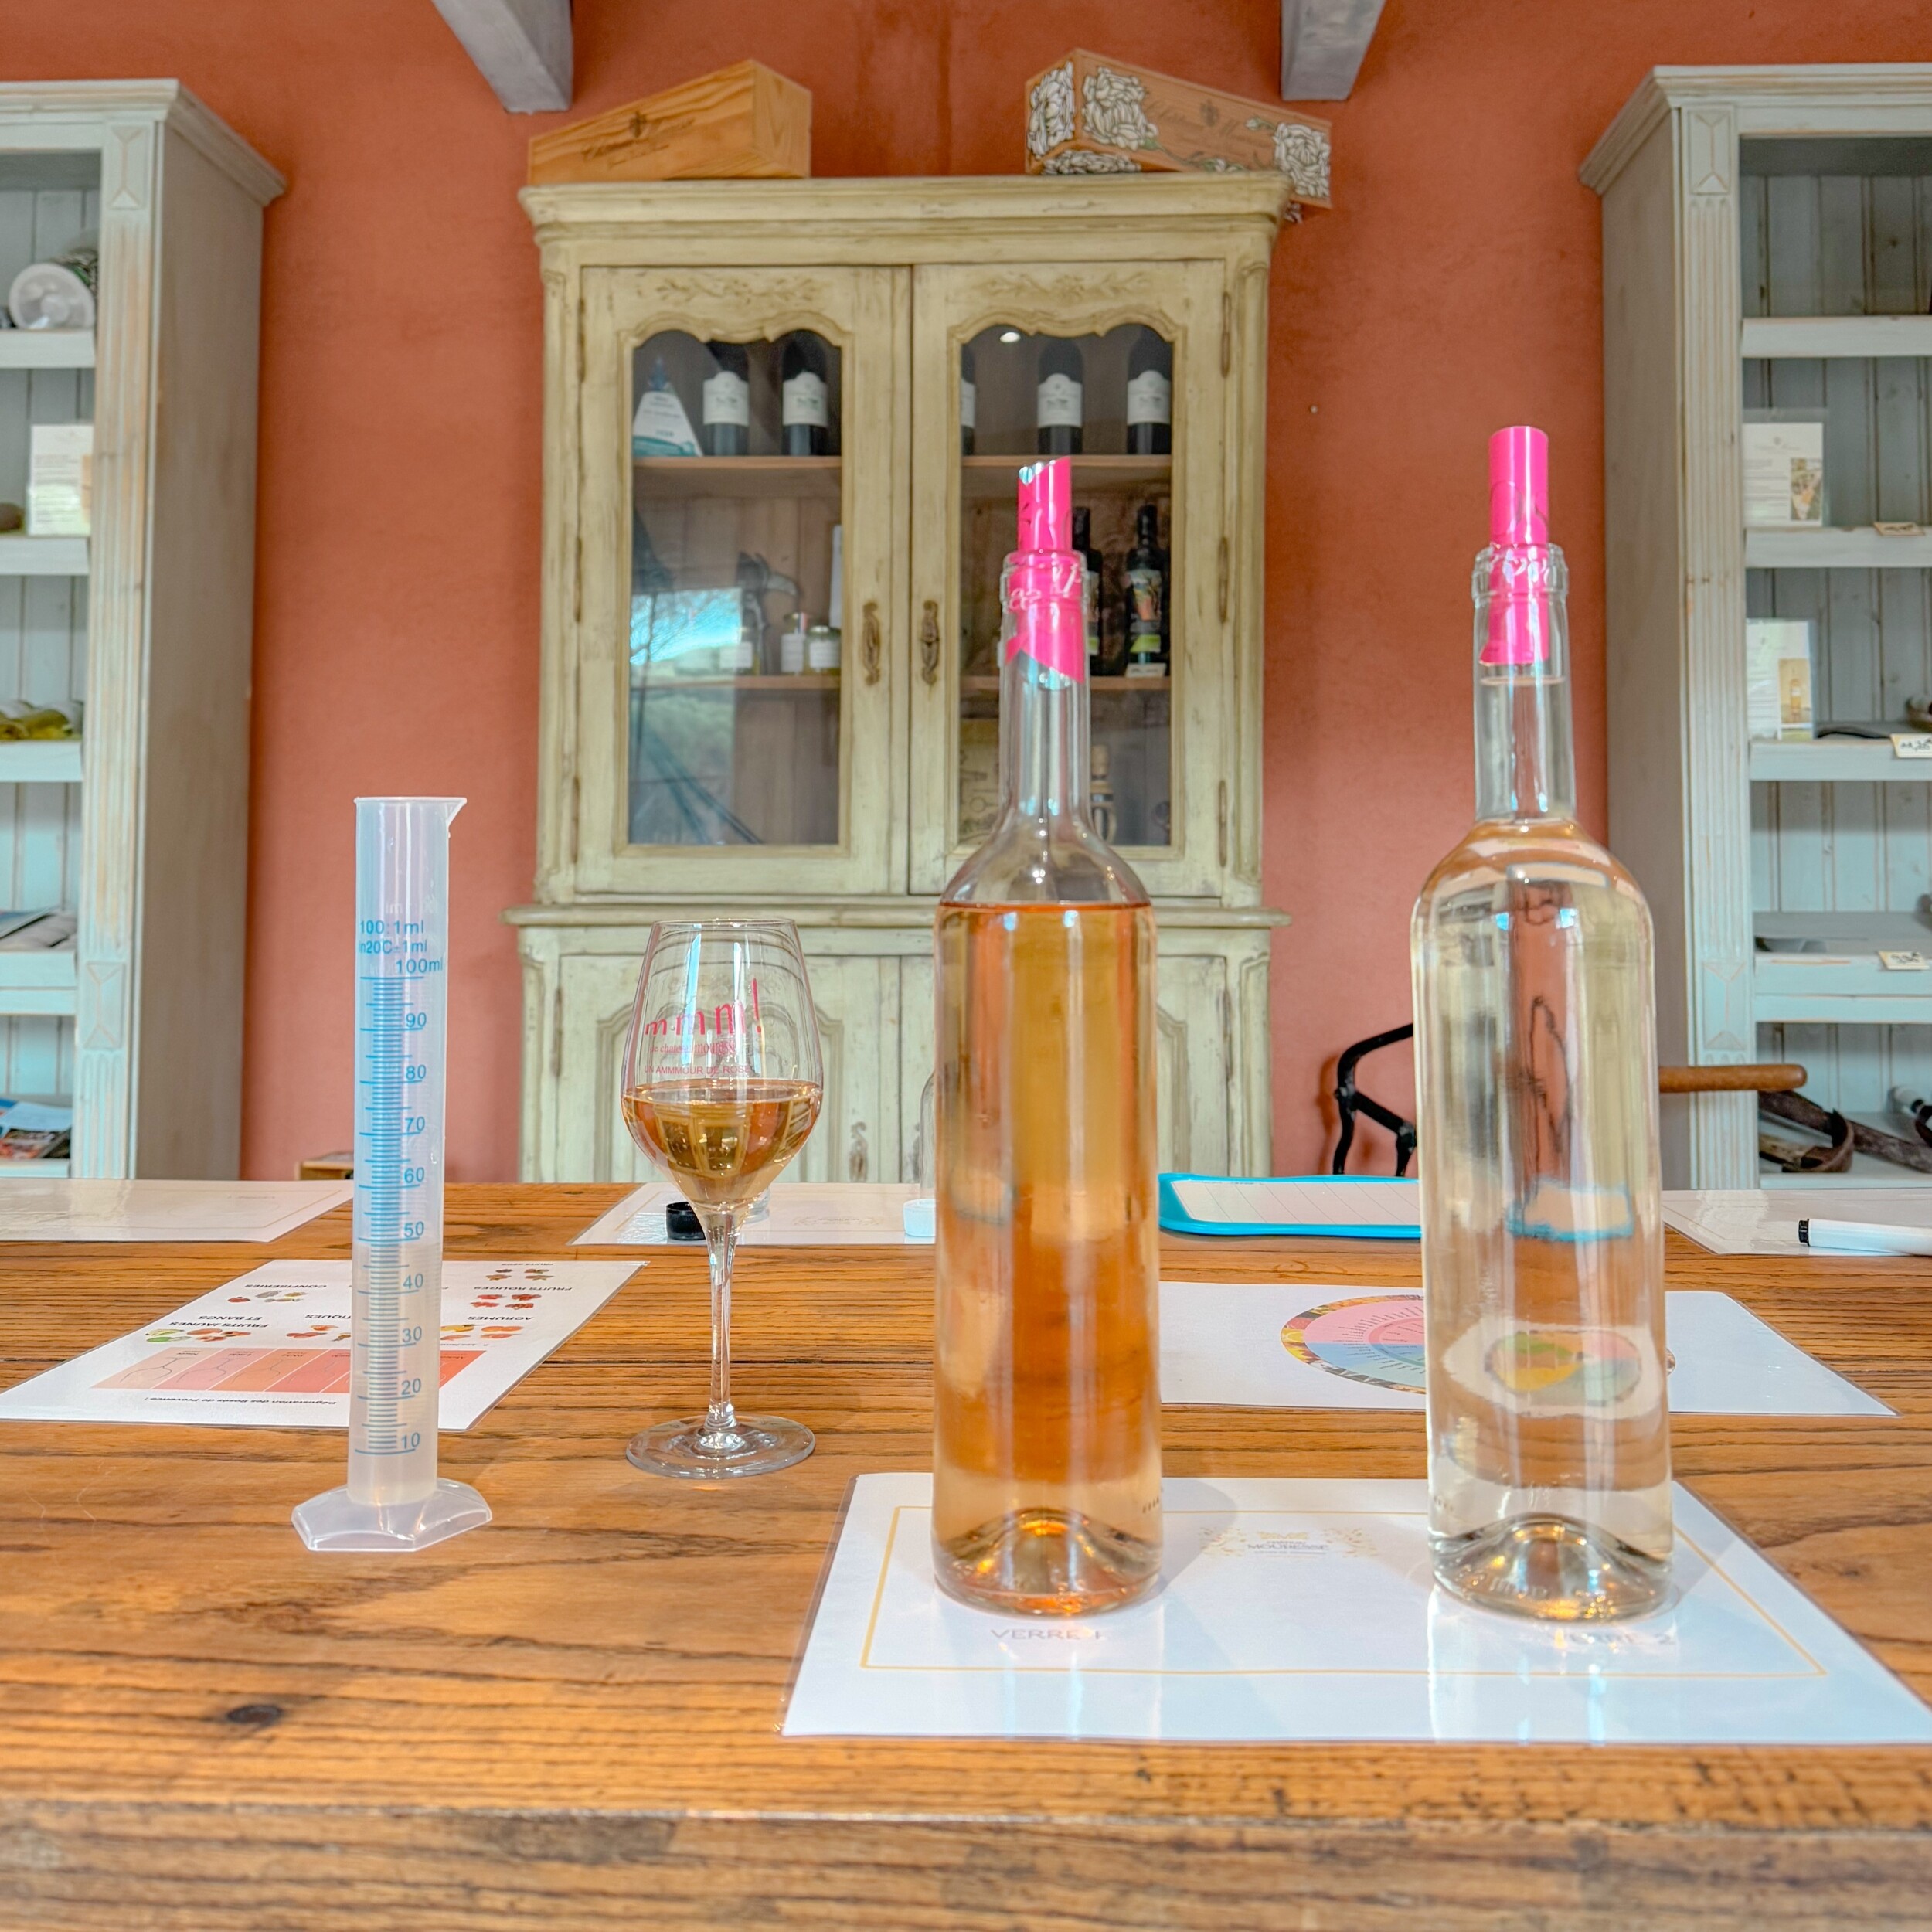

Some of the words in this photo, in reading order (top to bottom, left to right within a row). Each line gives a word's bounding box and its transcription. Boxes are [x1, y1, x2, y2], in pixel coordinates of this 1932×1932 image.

[406, 1012, 427, 1029] 90
[406, 1064, 427, 1080] 80
[655, 1066, 704, 1075] AMMMOUR
[405, 1116, 426, 1133] 70
[403, 1167, 425, 1184] 60
[403, 1221, 424, 1238] 50
[403, 1273, 423, 1290] 40
[402, 1326, 423, 1343] 30
[401, 1379, 421, 1396] 20
[400, 1433, 420, 1449] 10
[990, 1628, 1081, 1640] VERRE
